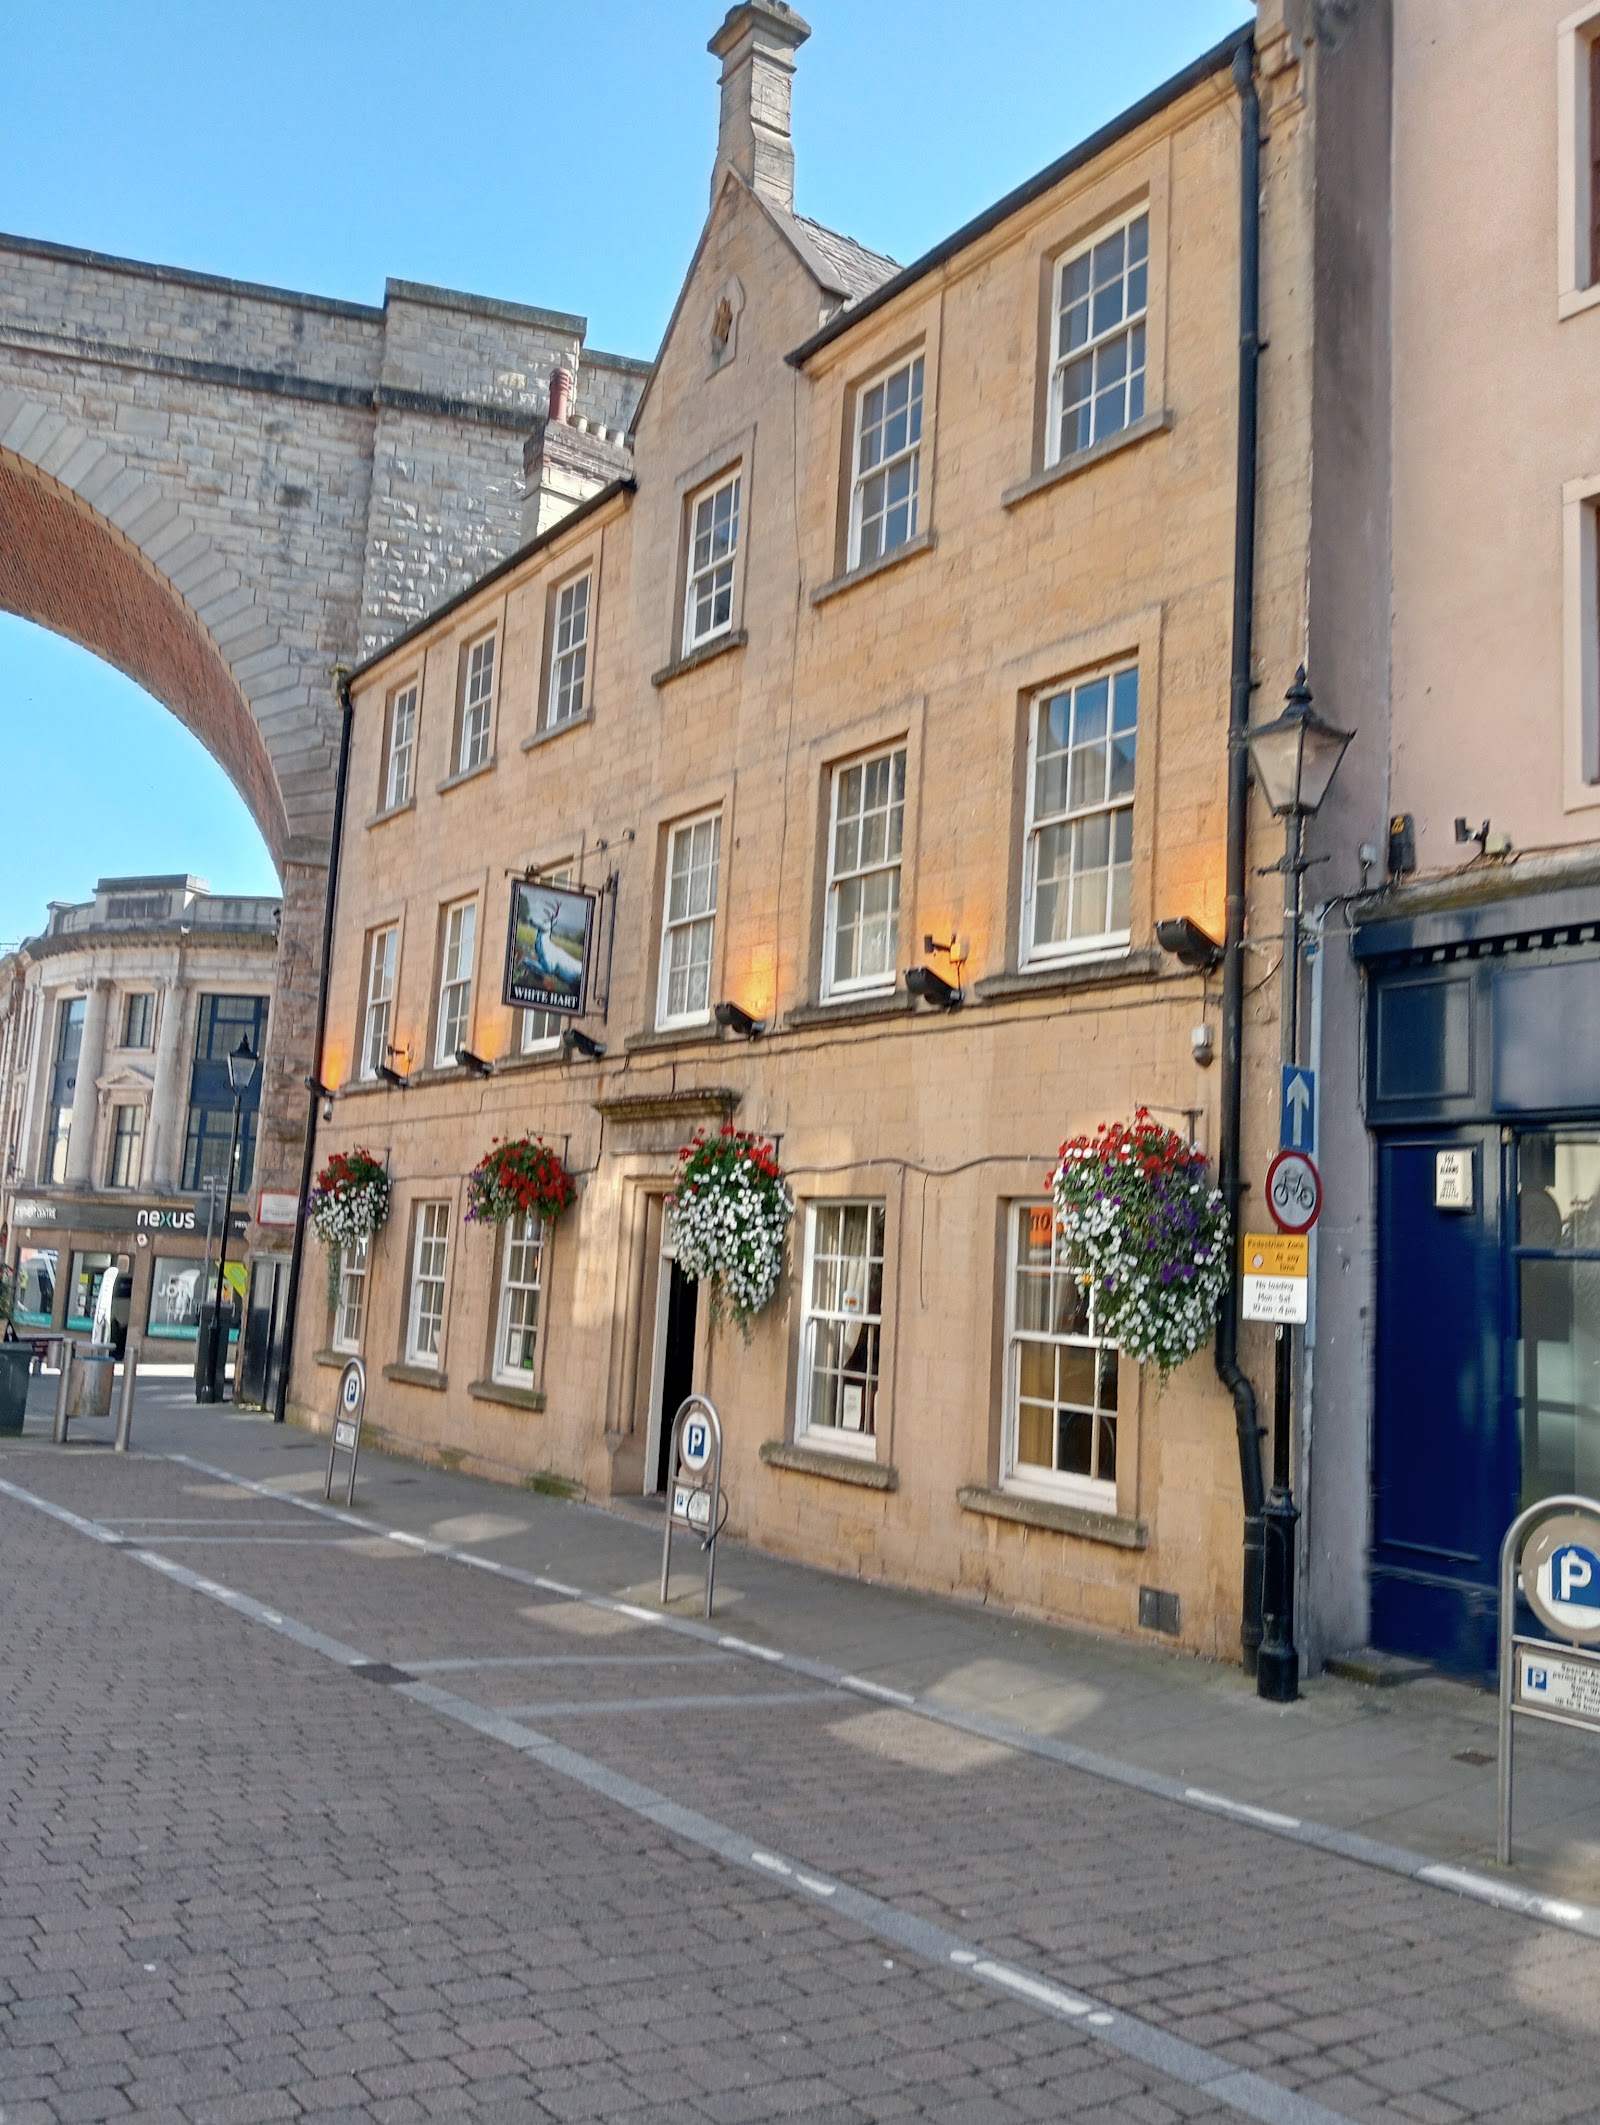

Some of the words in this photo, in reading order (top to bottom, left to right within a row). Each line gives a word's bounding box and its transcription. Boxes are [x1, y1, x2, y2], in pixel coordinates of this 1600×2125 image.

[514, 986, 548, 1003] WHITE
[550, 992, 578, 1009] HART
[137, 1209, 196, 1229] nexus
[1247, 1239, 1285, 1250] Pedestrian
[1287, 1240, 1305, 1250] Zone
[158, 1283, 193, 1297] JOIN
[1268, 1280, 1294, 1292] loading
[690, 1426, 703, 1455] P
[1560, 1553, 1592, 1600] P
[1532, 1667, 1545, 1688] P
